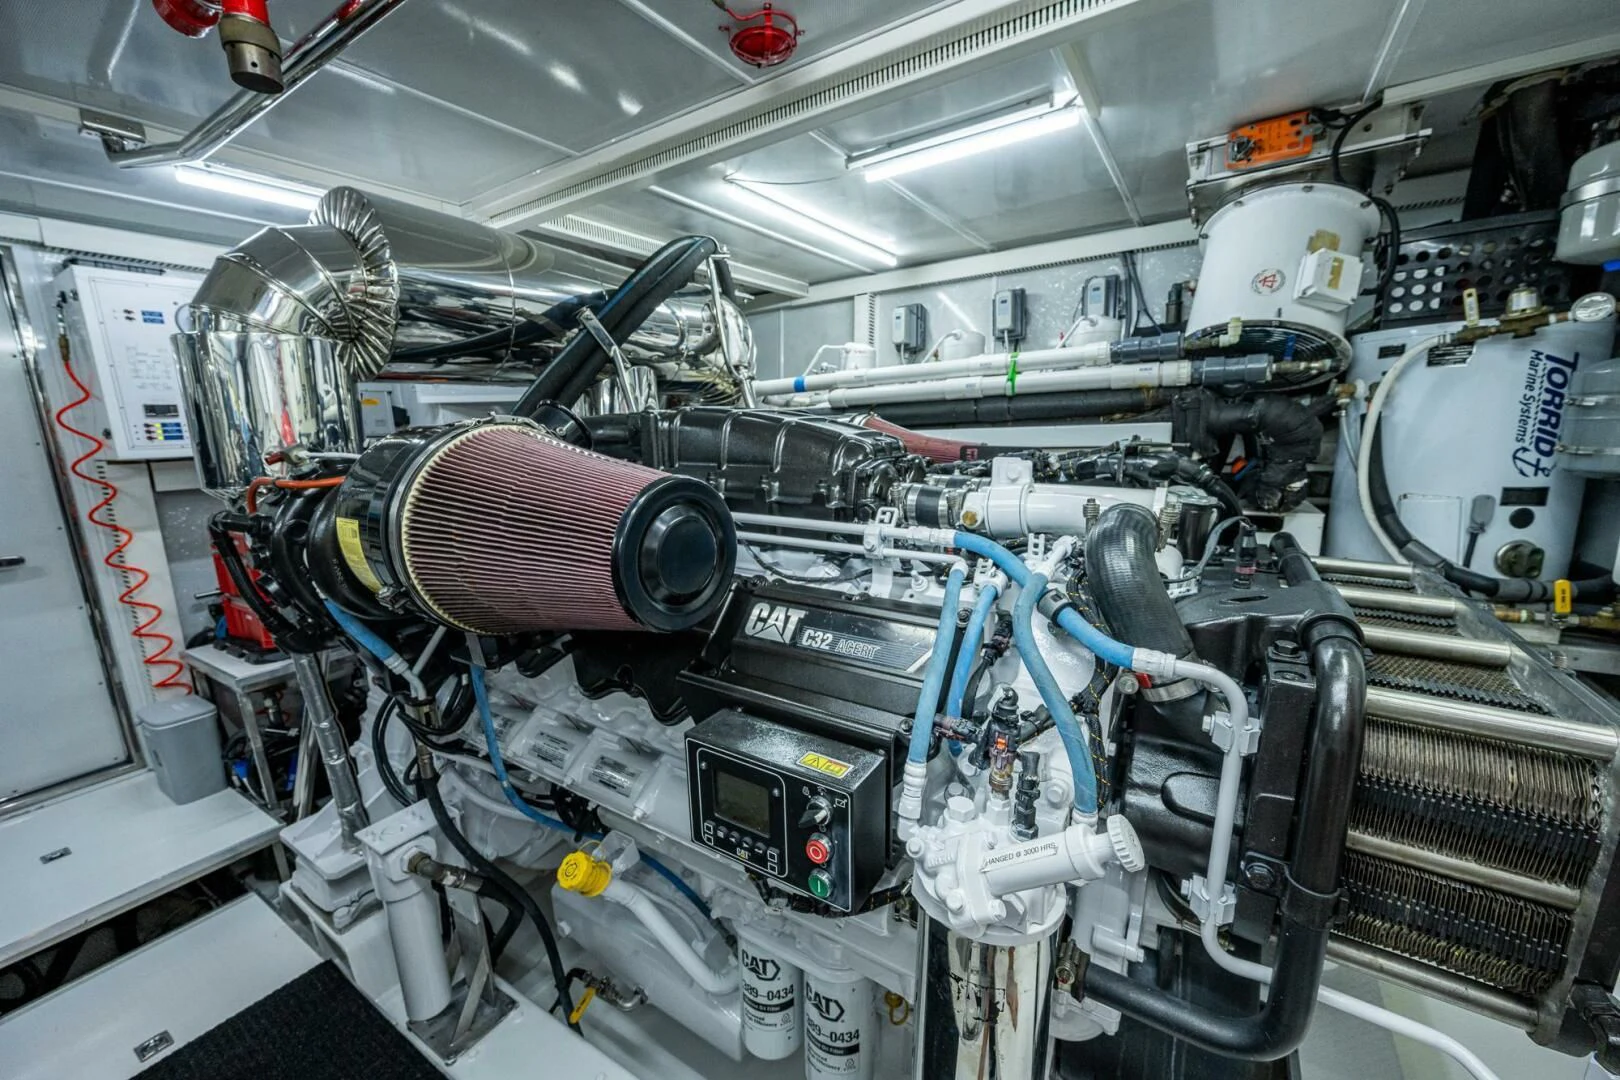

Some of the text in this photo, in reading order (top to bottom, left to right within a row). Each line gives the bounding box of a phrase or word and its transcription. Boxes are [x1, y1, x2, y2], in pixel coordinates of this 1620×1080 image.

[1515, 349, 1544, 444] Marine Systems
[1535, 352, 1580, 458] TORRID
[744, 602, 805, 644] CAT
[801, 629, 880, 660] C32 ACERT
[736, 847, 749, 859] CAT
[1023, 845, 1040, 857] 3000
[1040, 842, 1056, 852] HRS
[742, 948, 769, 977] CAT
[806, 981, 833, 1016] CAT
